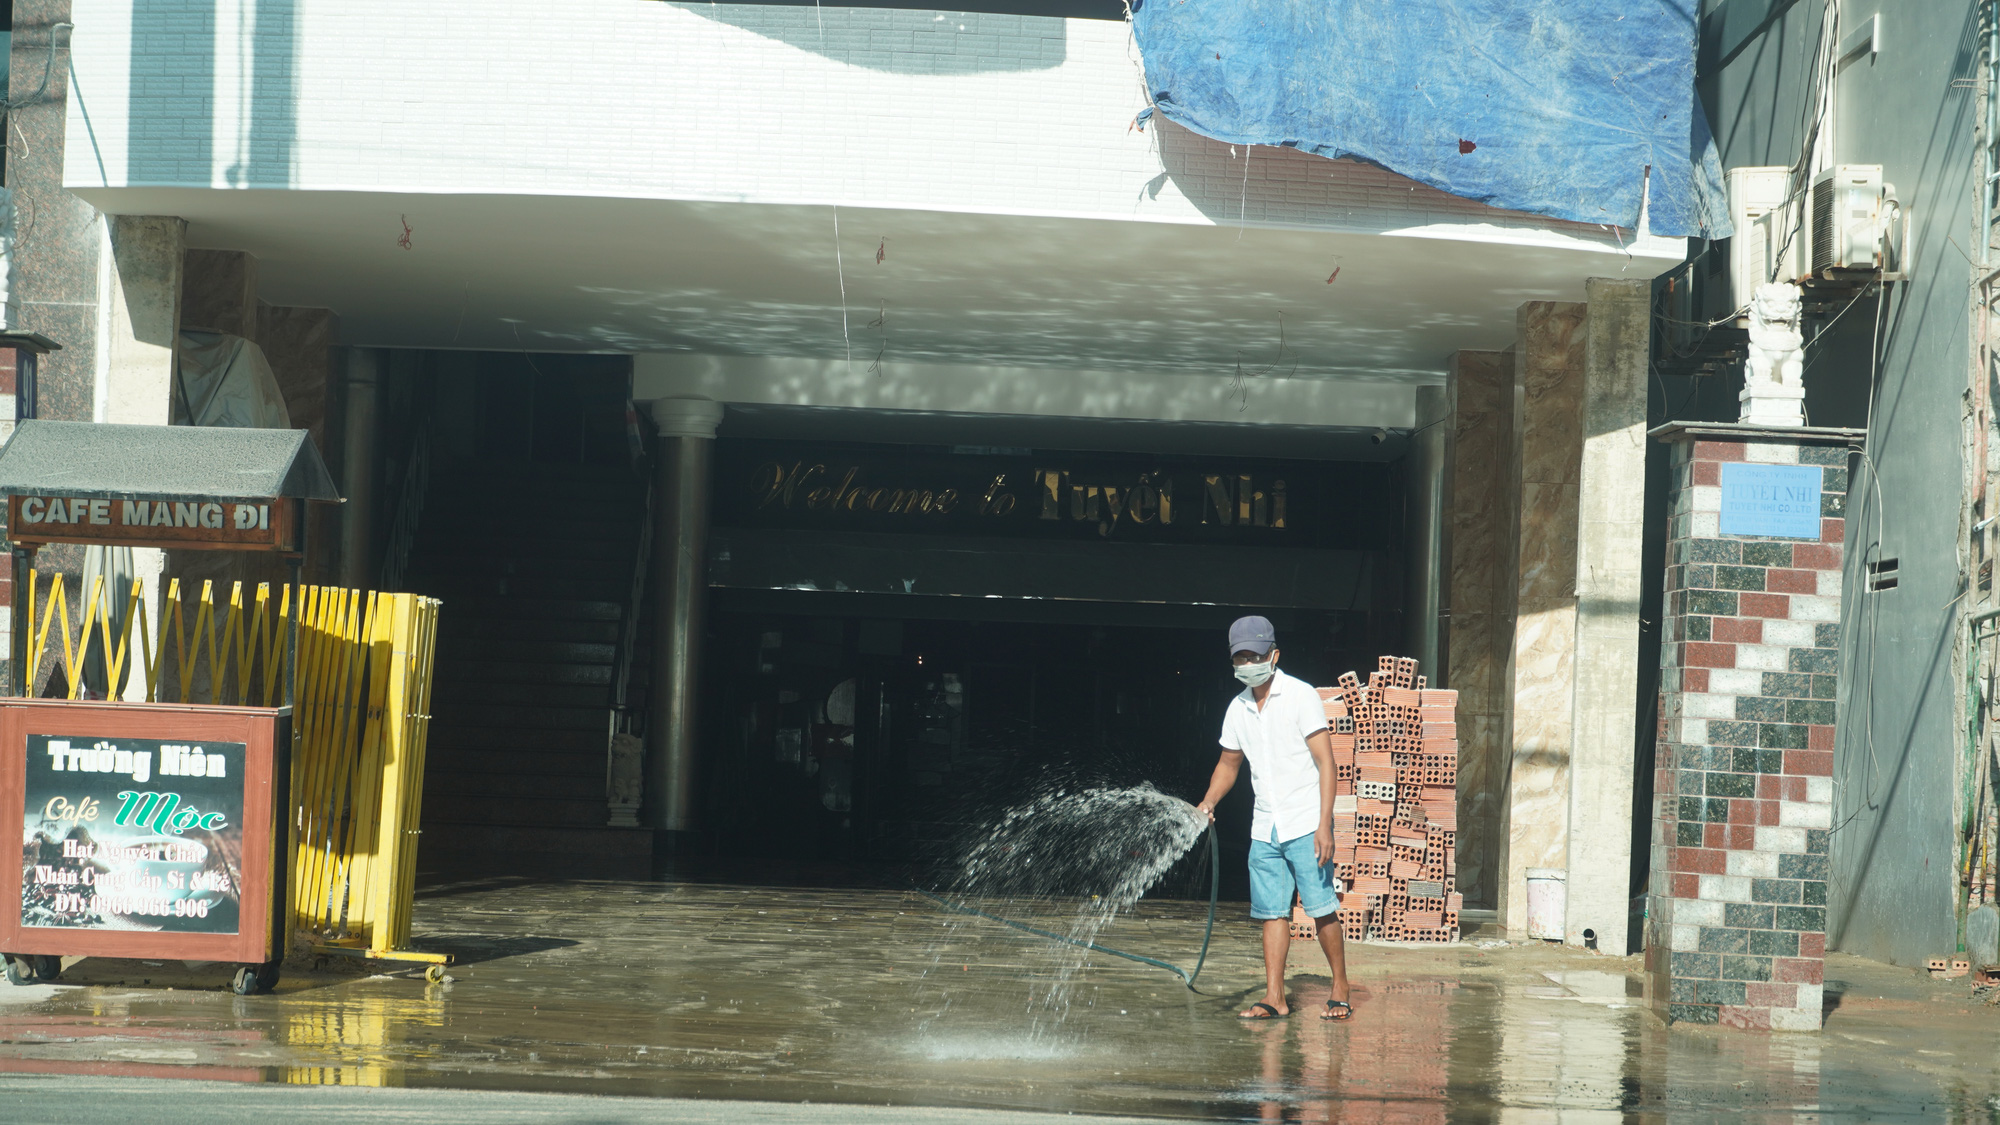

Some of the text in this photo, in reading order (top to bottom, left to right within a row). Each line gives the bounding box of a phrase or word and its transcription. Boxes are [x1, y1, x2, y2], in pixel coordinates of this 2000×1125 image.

[750, 459, 1288, 537] Welcome to Tuyết Nhi
[1760, 503, 1776, 511] NHI
[1784, 486, 1813, 502] NHI
[21, 497, 269, 530] CAFE MANG ĐI
[47, 740, 226, 782] Trường Niên
[46, 791, 228, 836] Café Mộc
[63, 839, 205, 865] Hạt Nguyên Chất
[33, 865, 78, 891] Nhận
[82, 866, 127, 892] Cung
[129, 868, 162, 892] Cấp
[189, 871, 205, 890] &
[54, 892, 208, 918] ĐT: 0966 966 906
